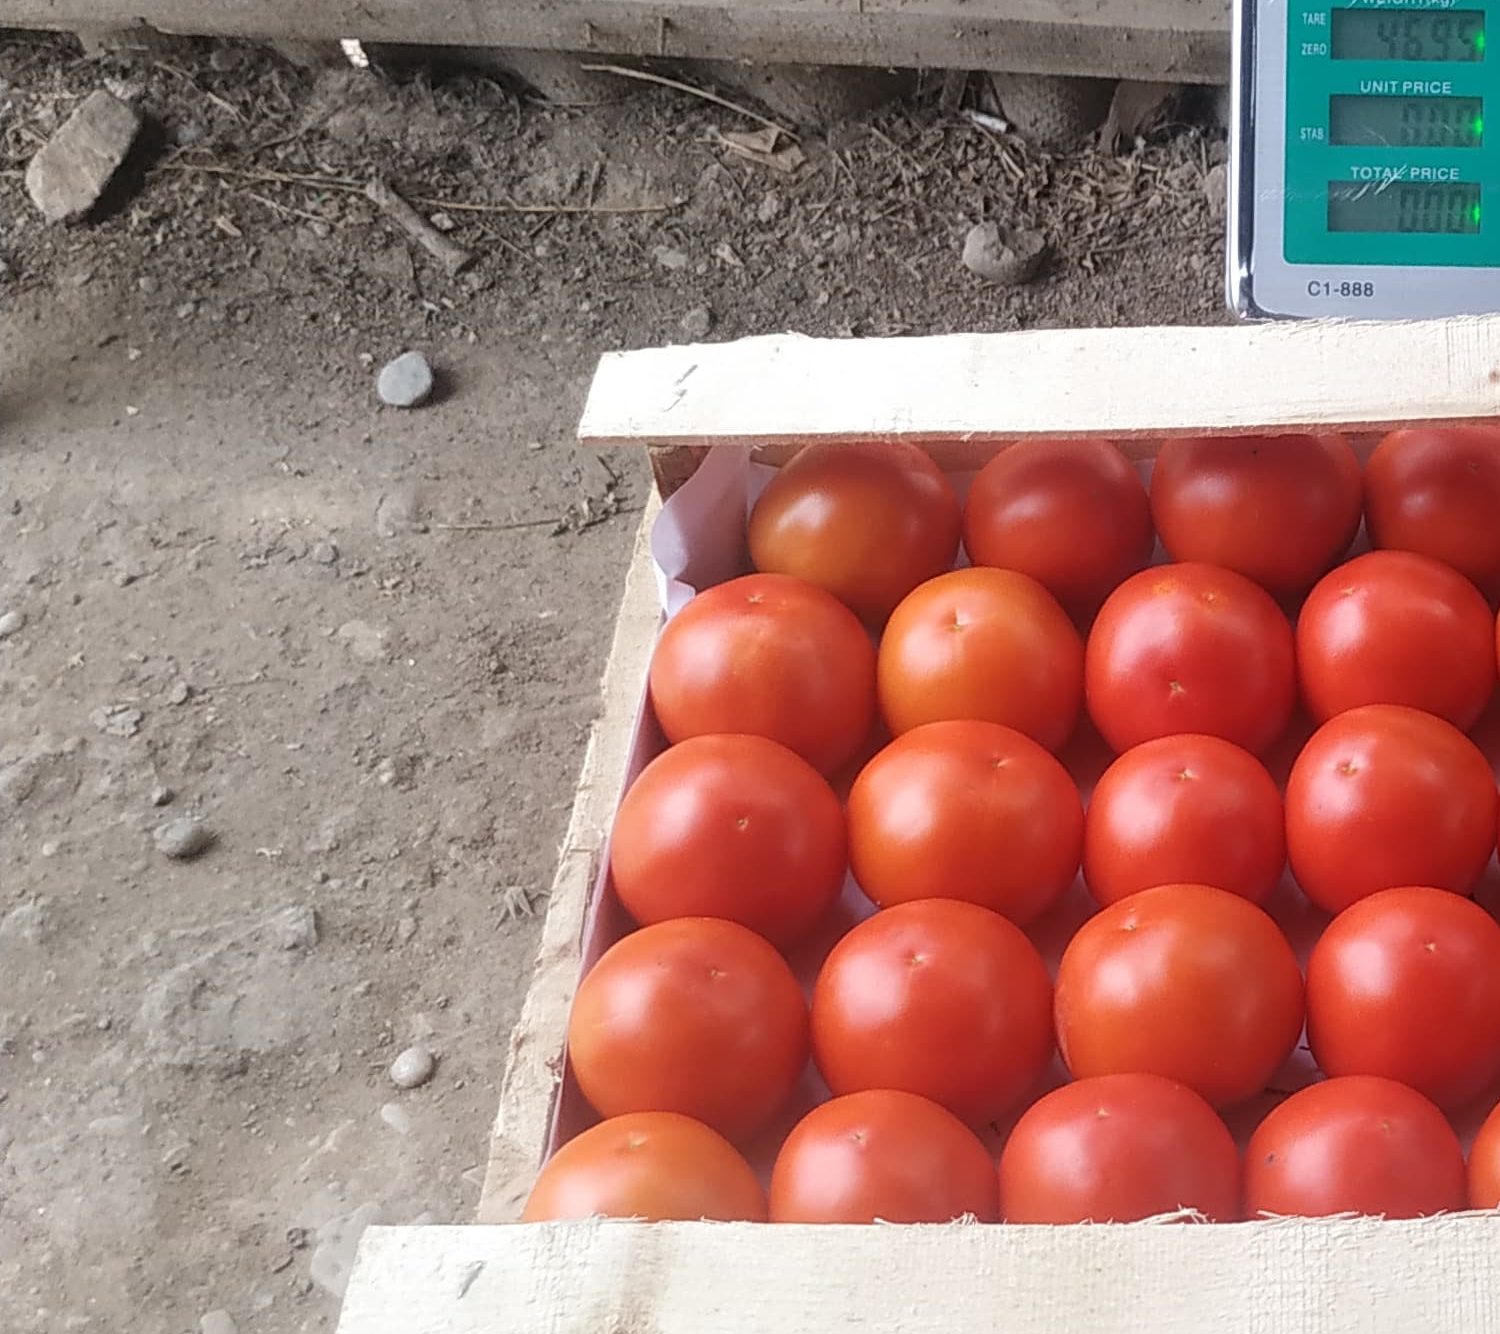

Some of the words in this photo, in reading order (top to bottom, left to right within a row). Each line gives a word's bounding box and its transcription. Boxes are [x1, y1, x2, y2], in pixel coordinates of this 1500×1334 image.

[1303, 13, 1326, 25] TARE
[1301, 43, 1327, 56] ZERO
[1361, 81, 1398, 93] UNIT
[1403, 81, 1452, 94] PRICE
[1300, 127, 1324, 140] STAB
[1350, 166, 1403, 180] TOTAL
[1410, 167, 1460, 180] PRICE
[1307, 280, 1374, 297] C1-888
